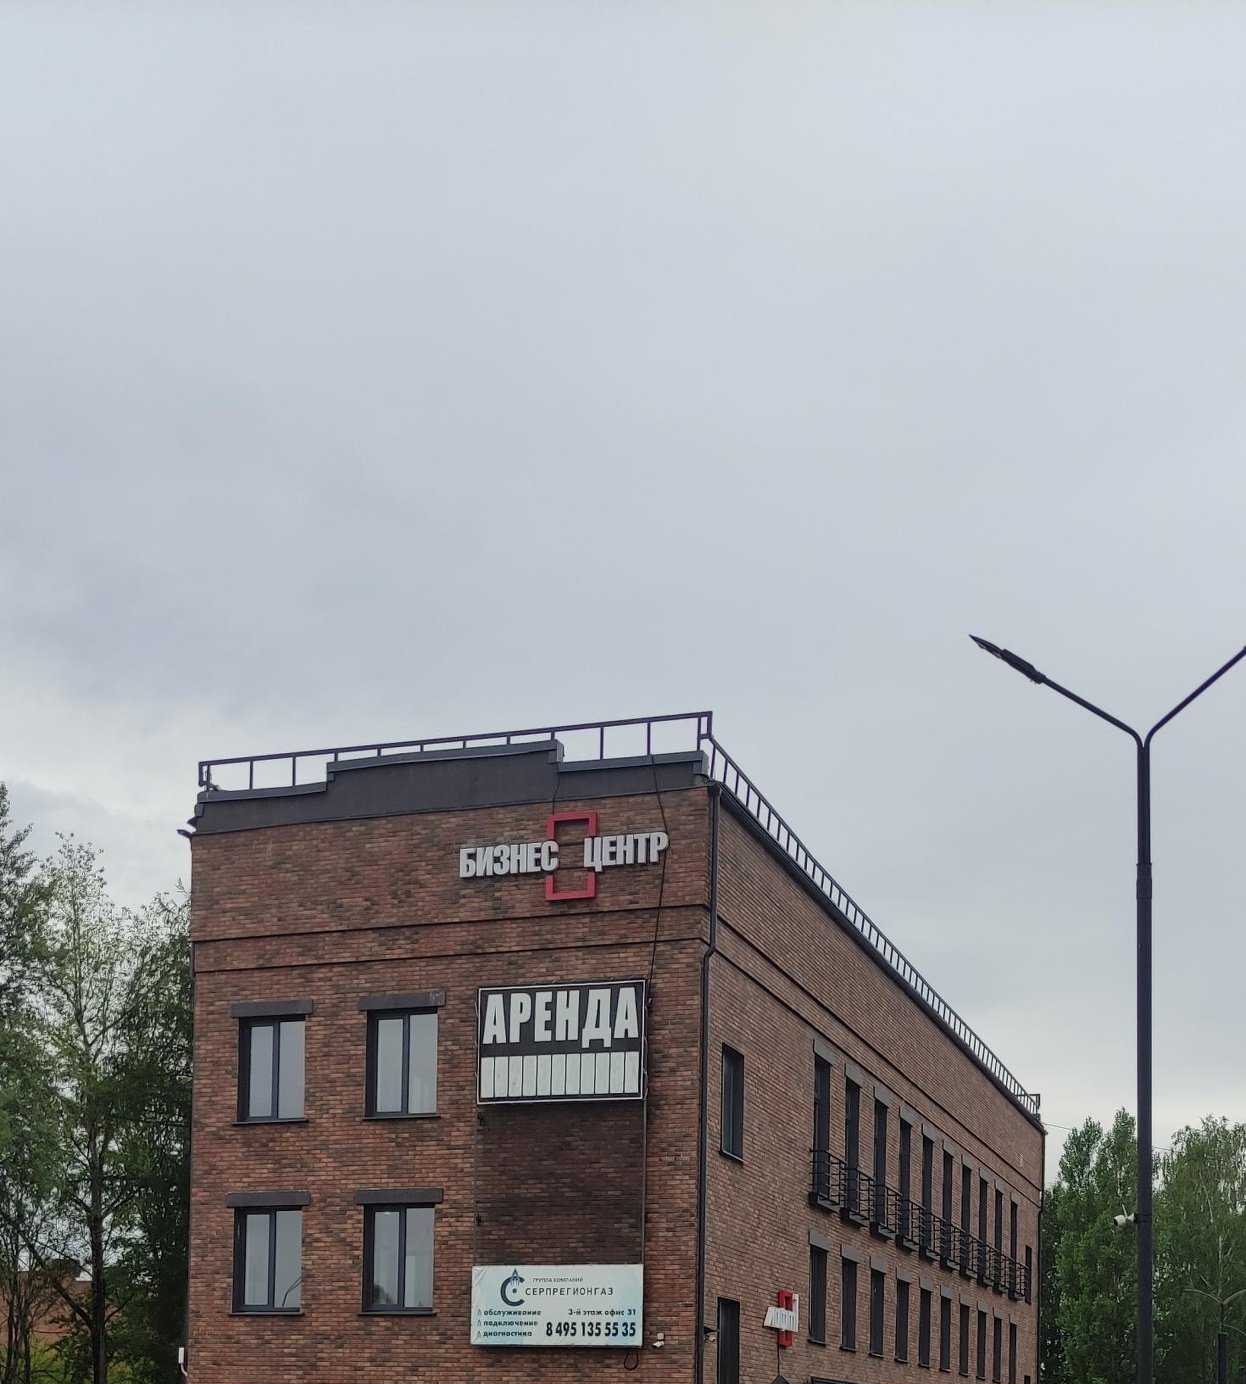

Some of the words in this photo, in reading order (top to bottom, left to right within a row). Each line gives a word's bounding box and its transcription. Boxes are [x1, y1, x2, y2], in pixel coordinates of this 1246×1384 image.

[459, 840, 559, 878] БИЗНЕС
[584, 831, 669, 872] ЦЕНТР
[482, 987, 639, 1048] АРЕНДА
[525, 1287, 614, 1296] СЕРПРЕГИОНГАЗ
[483, 1309, 542, 1317] обслуживание
[604, 1308, 625, 1317] офис
[627, 1308, 637, 1316] 31
[546, 1322, 553, 1336] 8
[555, 1322, 577, 1336] 495
[581, 1322, 601, 1336] 135
[604, 1322, 619, 1336] 55
[621, 1322, 637, 1336] 35
